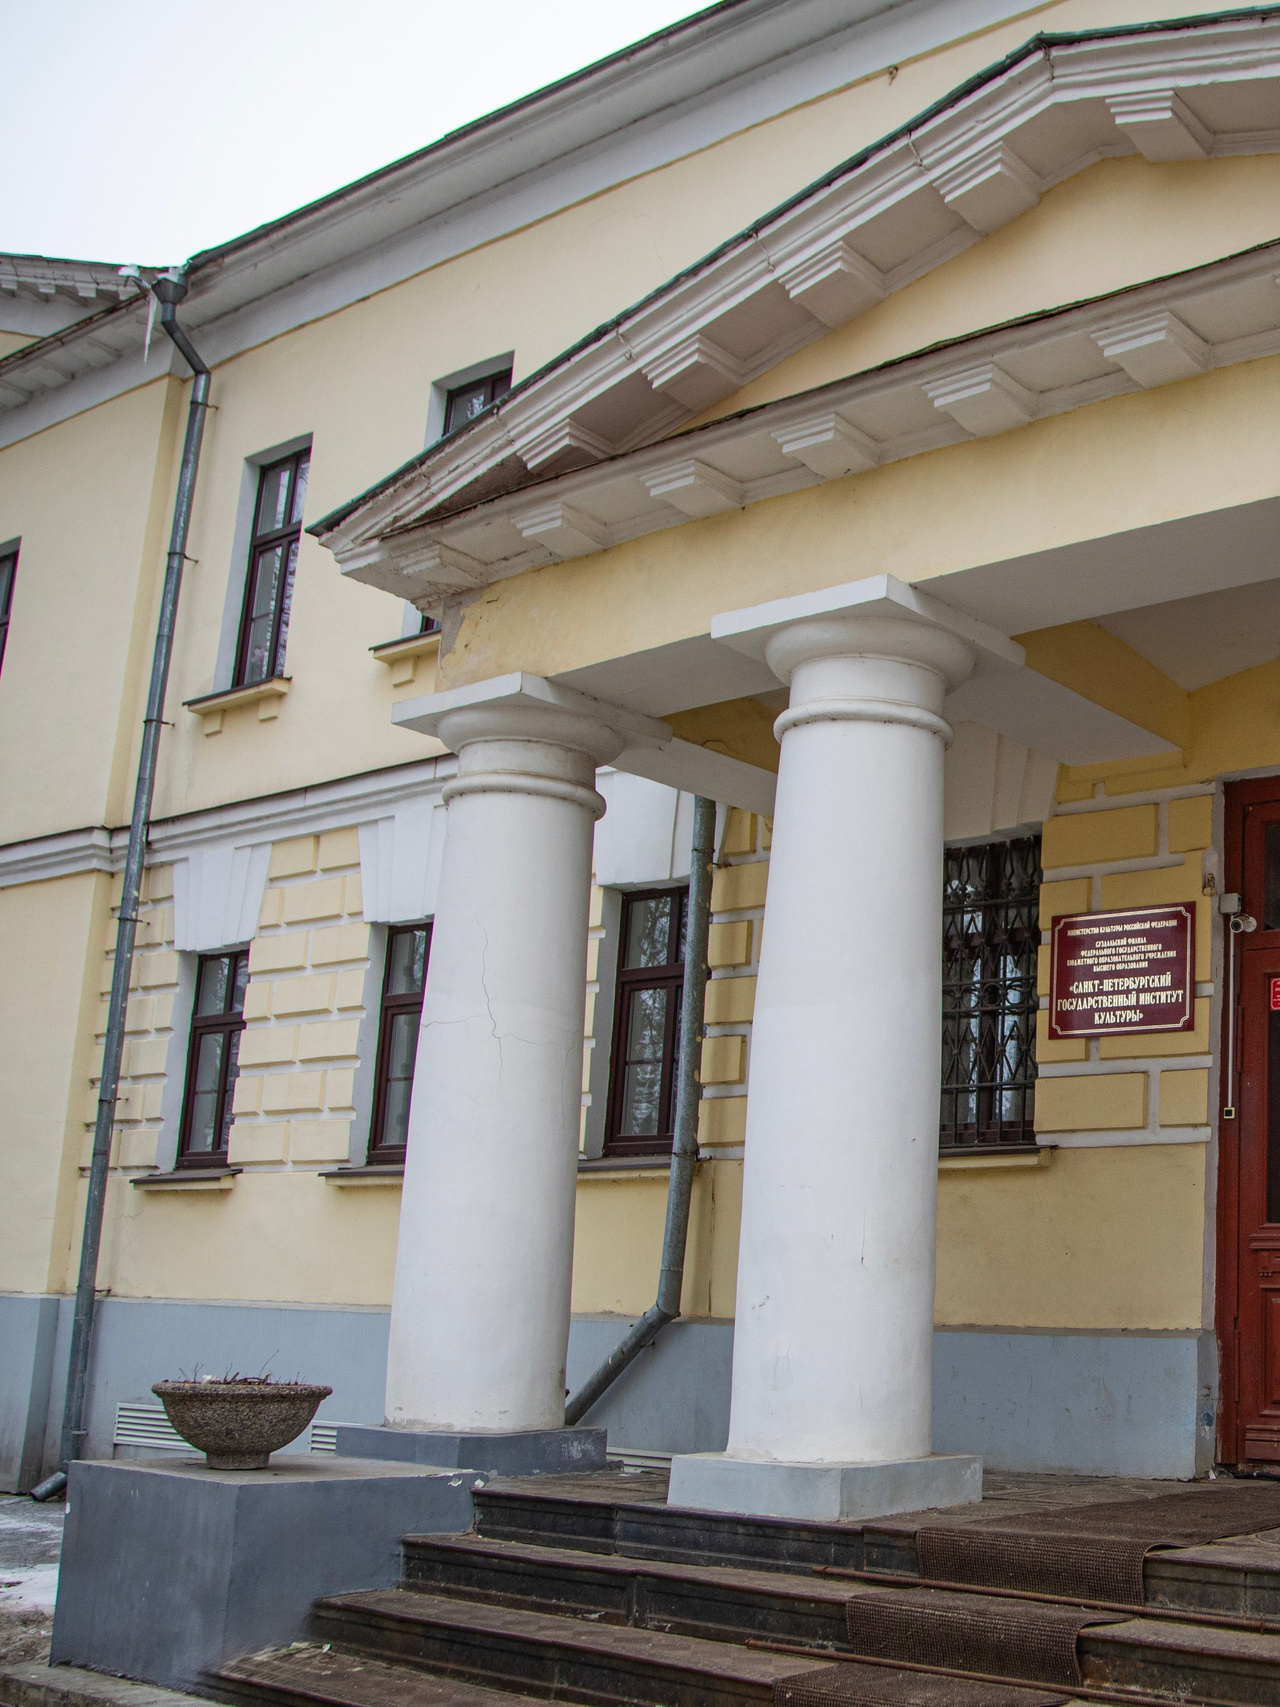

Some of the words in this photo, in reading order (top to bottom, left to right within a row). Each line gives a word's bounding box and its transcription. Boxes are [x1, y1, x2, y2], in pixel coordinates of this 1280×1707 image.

[1100, 925, 1122, 933] КУЛЬТУРЫ
[1124, 921, 1150, 931] РОССИЙСКОЙ
[1096, 937, 1126, 948] СУЗДАЛЬСКИЙ
[1128, 937, 1146, 945] ФИЛИАЛ
[1081, 947, 1115, 957] ФЕДЕРАЛЬНОГО
[1116, 944, 1162, 954] ГОСУДАРСТВЕННОГО
[1067, 955, 1098, 966] БЮДЖЕТНОГО
[1099, 953, 1144, 964] ОБРАЗОВАТЕЛЬНОГО
[1145, 951, 1177, 960] УЧРЕЖДЕНИЯ
[1093, 963, 1115, 972] ВЫСШЕГО
[1116, 961, 1148, 970] ОБРАЗОВАНИЯ
[1069, 972, 1171, 994] «САНКТ-ПЕТЕРБУРГСКИЙ
[1058, 991, 1137, 1011] ГОСУДАРСТВЕННЫЙ
[1140, 990, 1183, 1005] ИНСТИТУТ
[1095, 1009, 1143, 1024] КУЛЬТУРЫ»
